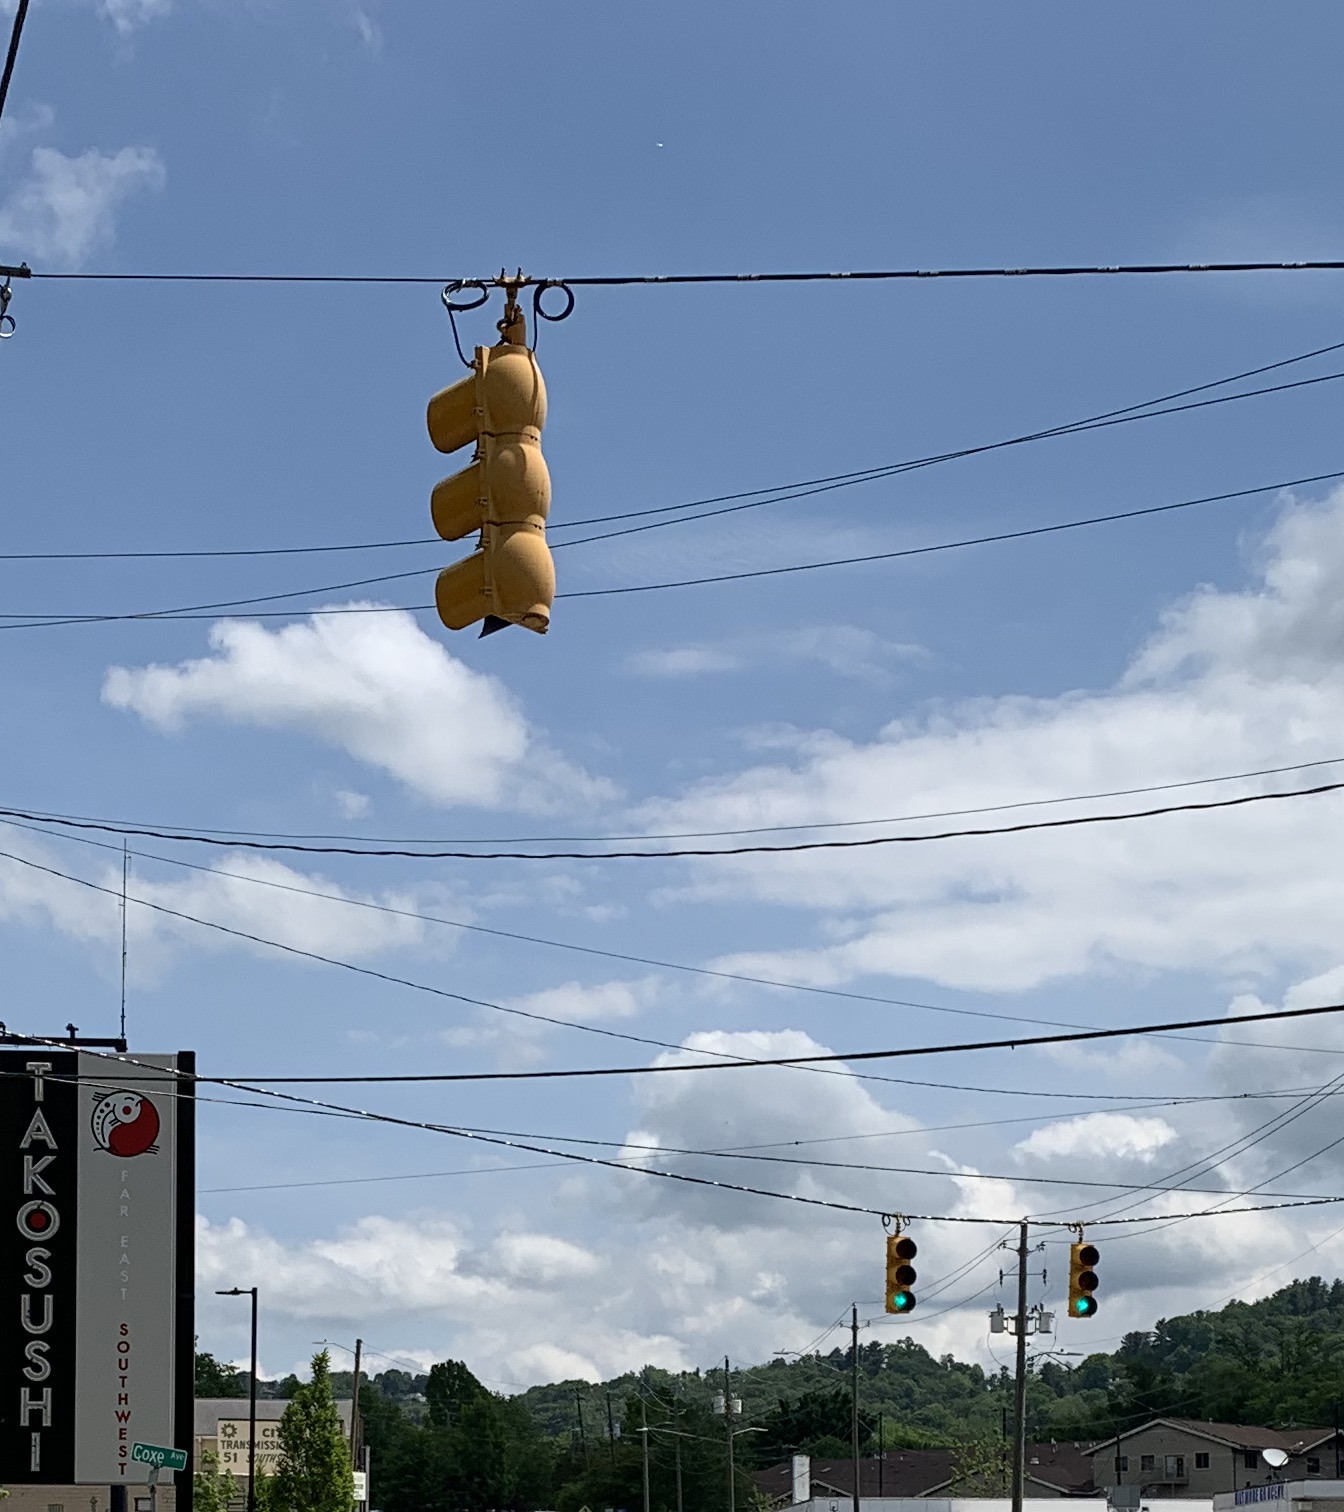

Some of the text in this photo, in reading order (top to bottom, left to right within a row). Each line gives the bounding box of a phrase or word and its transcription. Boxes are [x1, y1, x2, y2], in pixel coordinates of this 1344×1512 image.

[16, 1061, 60, 1472] TAKOSUSHI
[118, 1170, 131, 1300] FAR EAST
[115, 1323, 131, 1476] SOUTHWEST
[133, 1445, 185, 1464] Coxe Ave
[223, 1452, 238, 1463] 51
